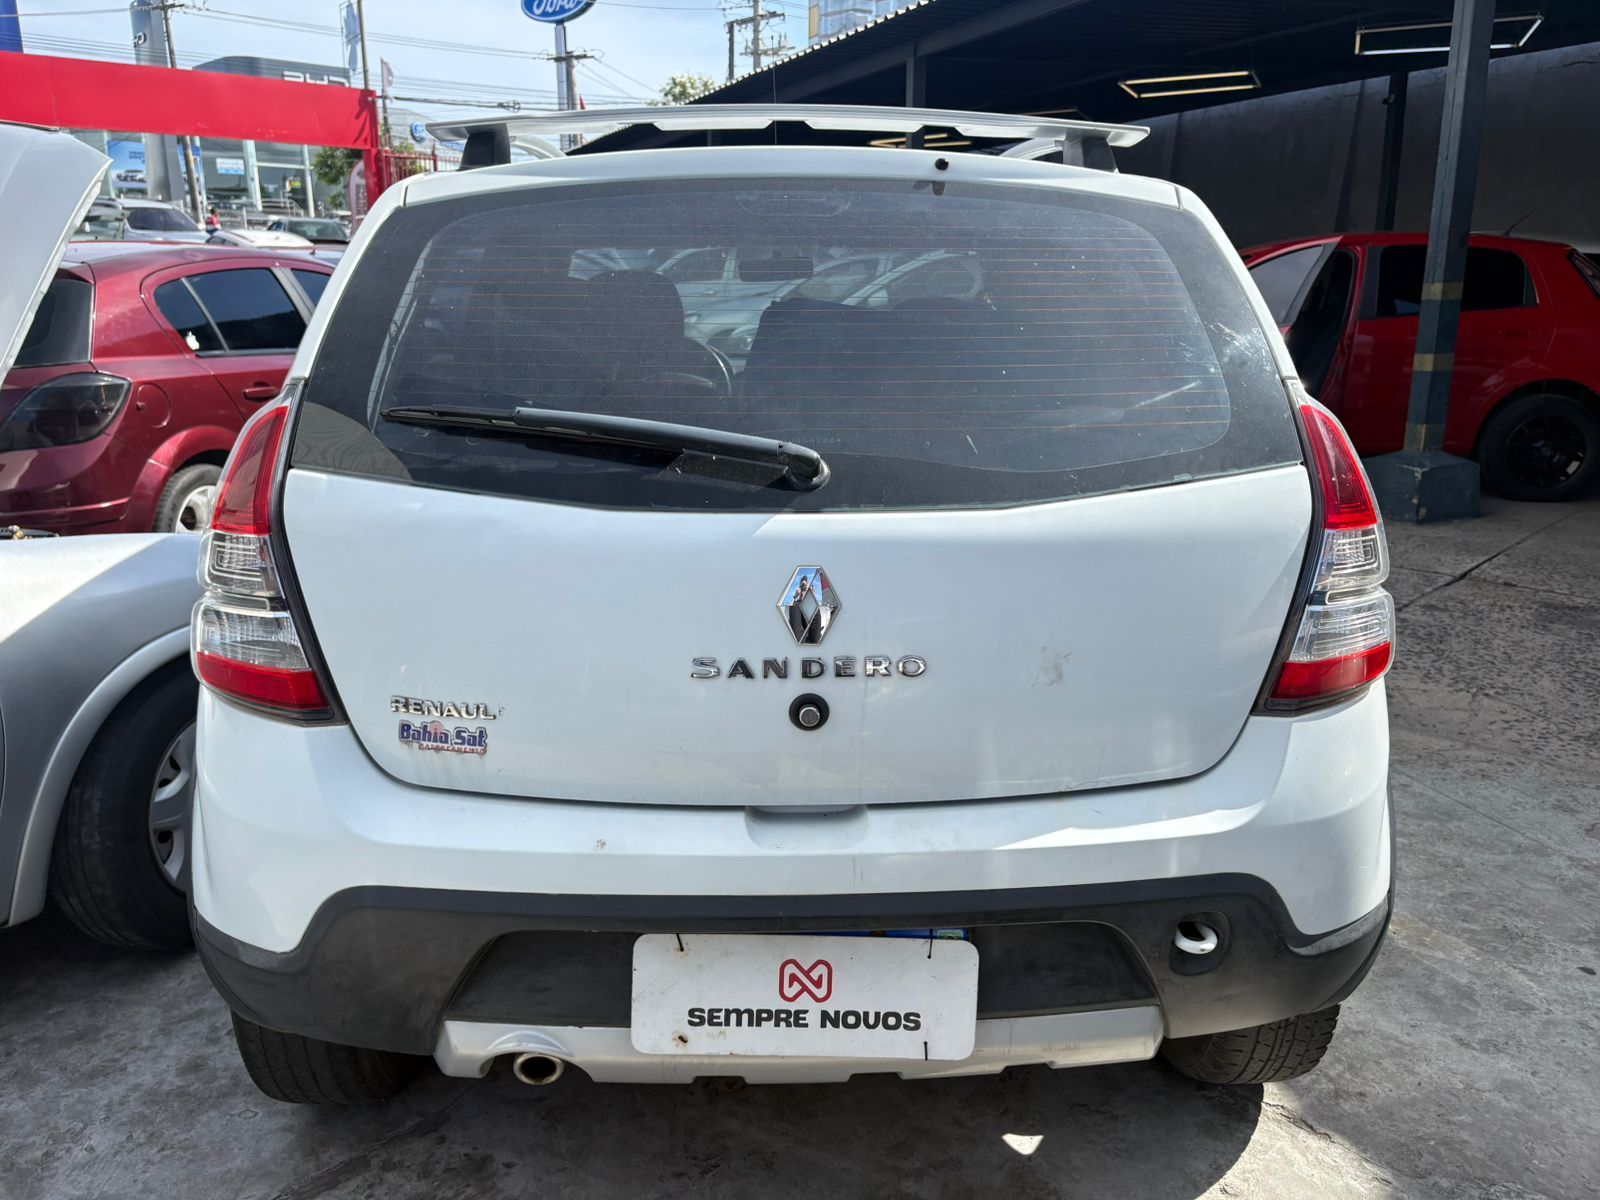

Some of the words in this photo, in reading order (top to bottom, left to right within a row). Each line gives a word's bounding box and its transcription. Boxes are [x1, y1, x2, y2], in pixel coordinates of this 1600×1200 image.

[691, 656, 926, 679] SANDERO
[390, 695, 496, 720] RENAUL
[401, 723, 449, 744] Bahia
[454, 729, 486, 747] Sat
[687, 1008, 809, 1028] SEMPRE
[820, 1010, 921, 1031] NOVOS
